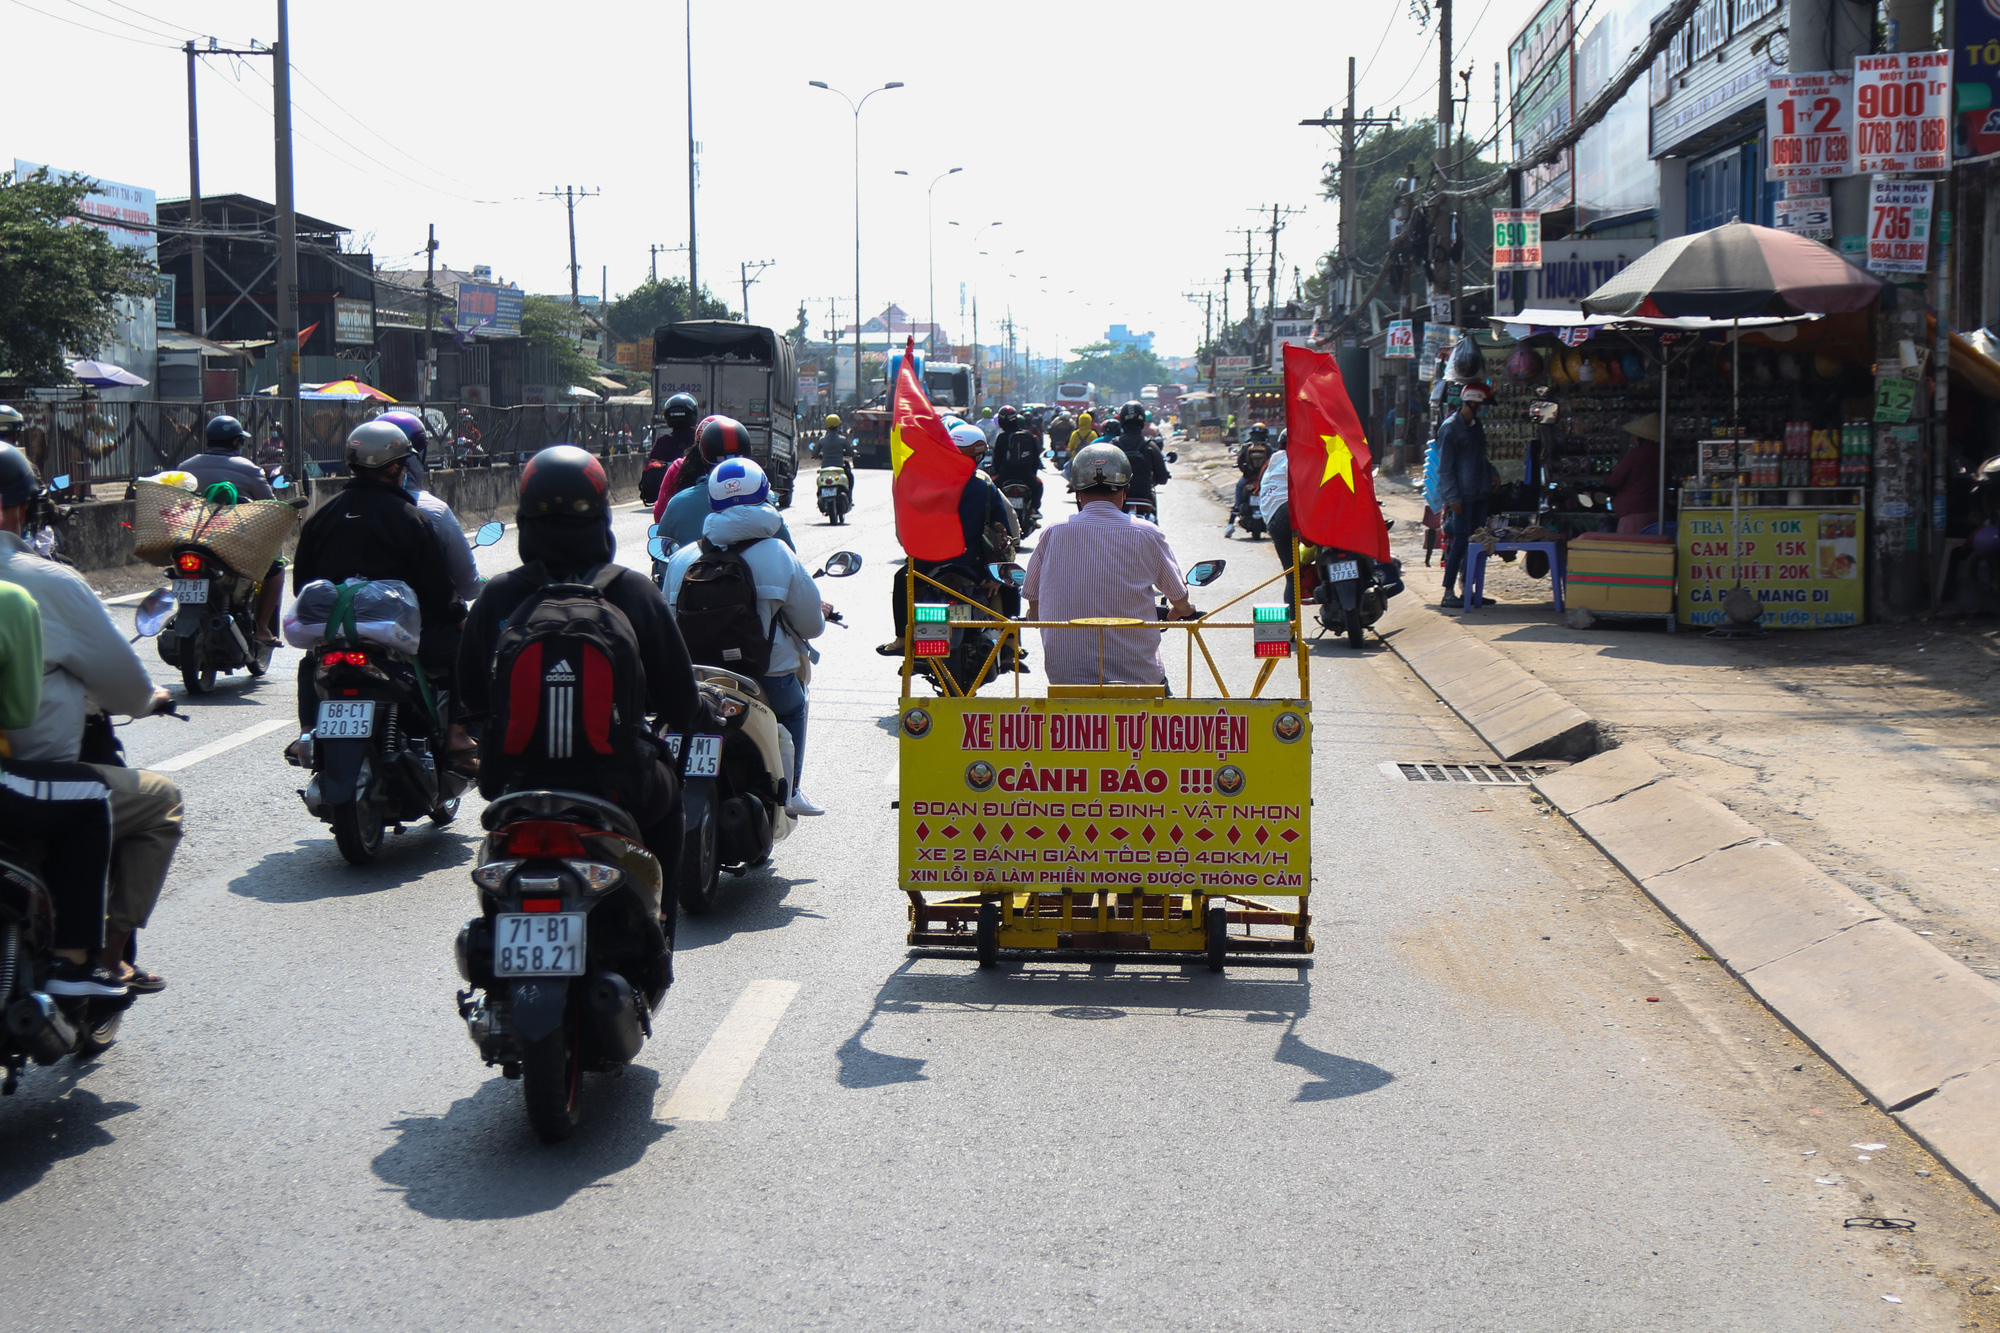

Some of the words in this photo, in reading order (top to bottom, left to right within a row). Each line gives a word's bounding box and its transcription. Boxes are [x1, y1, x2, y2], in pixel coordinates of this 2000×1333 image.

[1858, 81, 1925, 119] 900
[1928, 80, 1947, 96] Tr
[1777, 99, 1795, 134] 1
[1814, 97, 1841, 132] 2
[1859, 121, 1892, 154] 0768
[1896, 120, 1917, 153] 219
[1921, 118, 1946, 151] 868
[1773, 138, 1802, 165] 0909
[1806, 137, 1822, 163] 117
[1825, 135, 1847, 162] 838
[1778, 169, 1784, 177] 5
[1798, 168, 1810, 176] 20
[1820, 166, 1842, 175] SHR
[1860, 158, 1868, 172] 5
[1776, 213, 1794, 228] 1
[1807, 212, 1828, 224] 3
[1872, 206, 1912, 240] 735
[1497, 222, 1526, 247] 690
[1536, 252, 1590, 304] THUẬN
[1442, 303, 1450, 314] 2
[1390, 332, 1397, 346] 1
[1403, 331, 1413, 346] 2
[661, 383, 702, 392] 62L-8422
[1879, 391, 1892, 408] 1
[1896, 393, 1913, 410] 2
[1690, 516, 1724, 534] TRÀ
[1771, 520, 1802, 534] 10K
[1690, 541, 1729, 556] CAM
[1776, 541, 1807, 556] 15K
[1690, 562, 1726, 583] ĐẶC
[1779, 565, 1810, 580] 20K
[1757, 589, 1806, 602] MANG
[1812, 589, 1829, 602] ĐI
[546, 673, 576, 682] adidas
[328, 703, 365, 718] 68-C1
[320, 720, 369, 735] 320.35
[961, 712, 994, 751] XE
[1000, 705, 1046, 751] HÚT
[1050, 713, 1109, 752] ĐINH
[1114, 710, 1148, 760] TỰ
[1151, 707, 1248, 761] NGUYỆN
[671, 738, 711, 755] 6-M1
[997, 761, 1088, 793] CẢNH
[1100, 764, 1169, 794] BÁO
[1179, 768, 1213, 794] !!!
[913, 801, 978, 822] ĐOẠN
[983, 798, 1066, 817] ĐƯỜNG
[1071, 799, 1103, 817] CÓ
[1108, 804, 1165, 819] ĐINH
[1183, 800, 1228, 824] VẬT
[1232, 805, 1300, 825] NHỌN
[917, 848, 947, 862] XE
[953, 849, 967, 862] 2
[973, 845, 1037, 863] BÁNH
[1043, 846, 1099, 863] GIẢM
[1103, 845, 1151, 863] TỐC
[1156, 846, 1190, 868] ĐỘ
[1195, 851, 1289, 865] 40KM/H
[910, 869, 938, 882] XIN
[943, 865, 968, 882] LỖI
[973, 869, 997, 883] ĐÃ
[1002, 868, 1034, 884] LÀM
[1040, 865, 1085, 884] PHIỀN
[1091, 872, 1143, 885] MONG
[1147, 872, 1196, 888] ĐƯỢC
[1201, 871, 1258, 886] THÔNG
[1263, 870, 1302, 886] CẢM
[510, 917, 569, 943] 71-B1
[501, 945, 576, 971] 858.21
